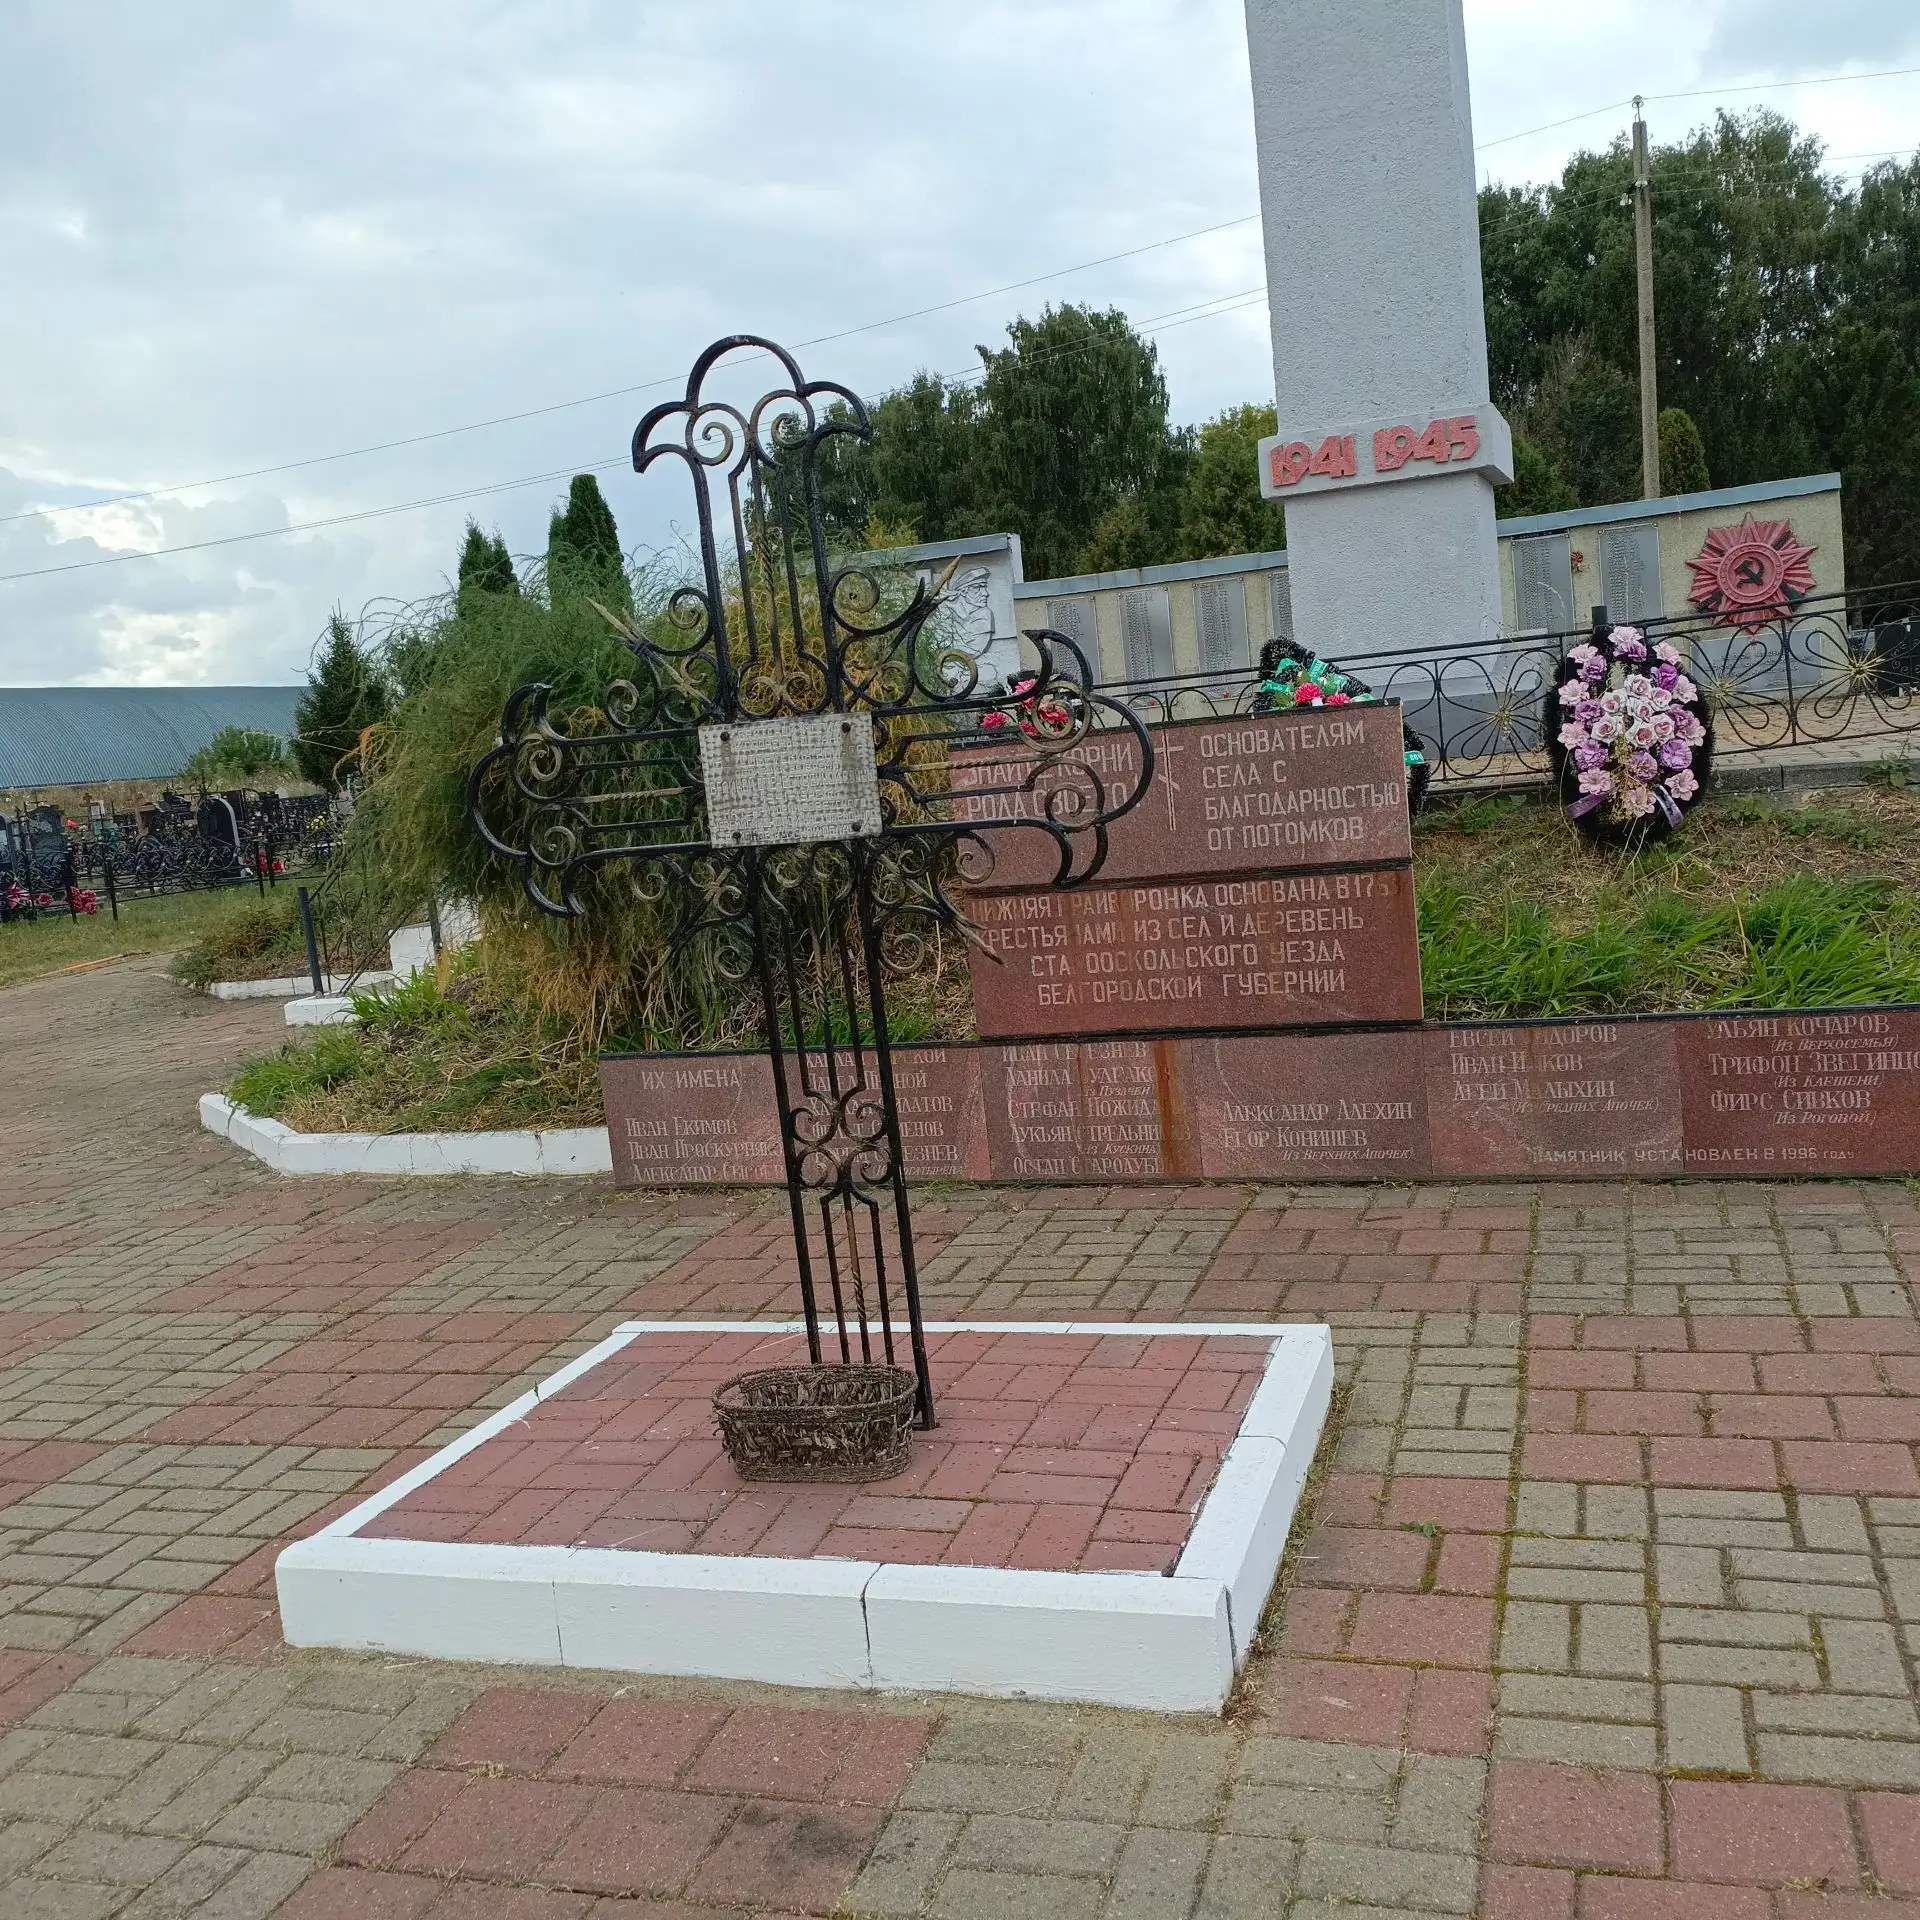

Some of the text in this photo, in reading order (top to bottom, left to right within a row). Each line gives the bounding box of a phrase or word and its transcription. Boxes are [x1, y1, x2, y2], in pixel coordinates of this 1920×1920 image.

[1271, 415, 1481, 487] 1941 1945
[1200, 720, 1365, 758] ОСНОВАТЕЛЯМ
[1202, 760, 1288, 789] СЕЛА С
[1204, 782, 1400, 821] БЛАГОДАРНОСТЬЮ
[1207, 816, 1364, 851] ОТ ПОТОМКОВ
[1214, 879, 1330, 906] ОСНОВАНА
[1335, 875, 1351, 899] В
[1134, 919, 1161, 942] ИЗ
[1168, 915, 1211, 940] СЕЛ
[1220, 914, 1236, 936] И
[1241, 906, 1364, 937] ДЕРЕВЕНЬ
[1031, 938, 1346, 977] СТАООСКОЛЬСКОГО УЕЗДА
[1038, 968, 1346, 1006] БЕЛГОРОДСКОЙ ГУБЕРНИИ
[1707, 1014, 1890, 1040] УЛЬЯН КОЧАРОВ
[1451, 1053, 1505, 1075] ИВАН
[1708, 1053, 1802, 1076] ТРИФОН
[640, 1071, 666, 1090] ИХ
[1004, 1067, 1074, 1087] ДАНИЛА
[1453, 1079, 1507, 1101] АГЕЙ
[1710, 1089, 1871, 1112] ФИРС СИВКОВ
[1223, 1099, 1414, 1122] АЛЕКСАНДР АЛЕХИН
[625, 1115, 738, 1137] ИВАН ЕКИМОВ
[1222, 1127, 1270, 1148] ЕГОР
[628, 1140, 671, 1160] ИВАН
[1531, 1149, 1626, 1163] ПАМЯТНИК
[1635, 1148, 1758, 1163] УСТАНОВЛЕН
[1763, 1147, 1776, 1160] В
[631, 1163, 717, 1183] АЛЕКСАНДР
